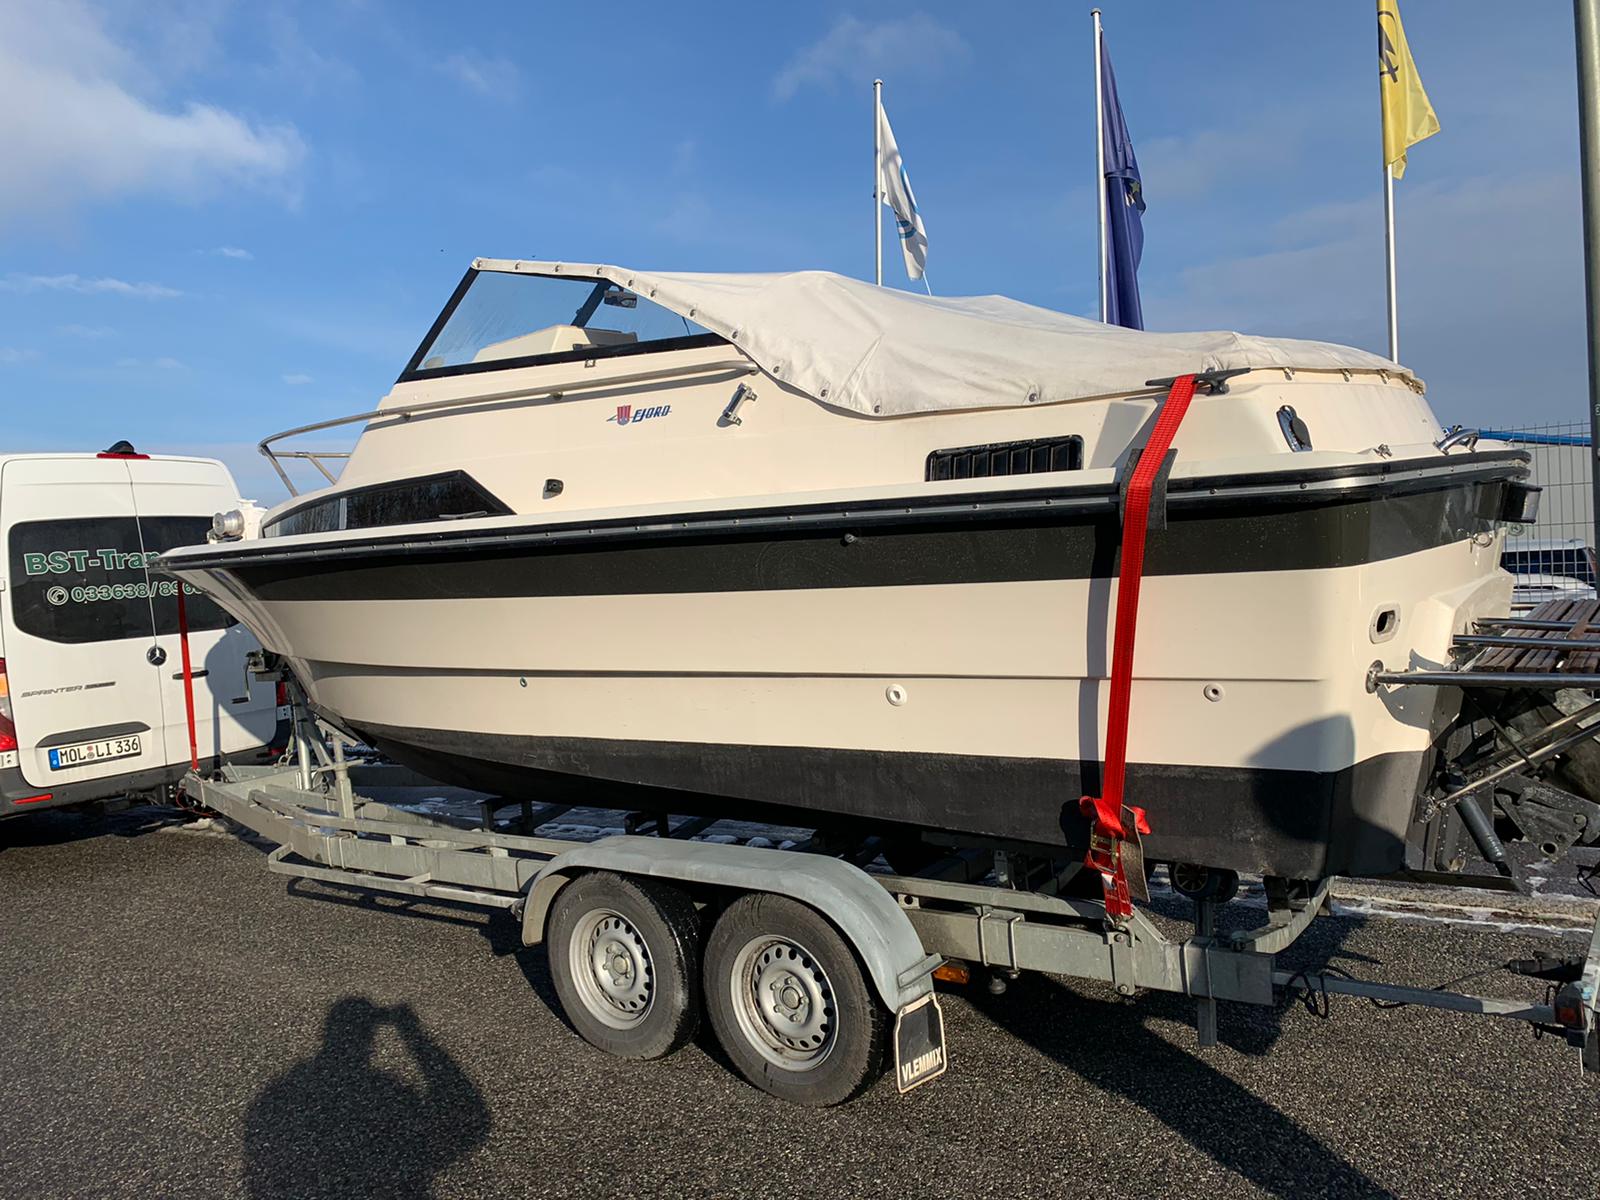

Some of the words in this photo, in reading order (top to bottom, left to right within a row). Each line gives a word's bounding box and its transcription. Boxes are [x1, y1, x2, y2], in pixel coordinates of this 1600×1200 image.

[21, 685, 83, 698] SPRINTER
[59, 748, 87, 764] MOL
[95, 742, 112, 757] LI
[115, 738, 139, 754] 336
[901, 1046, 943, 1082] VLEMMIX
